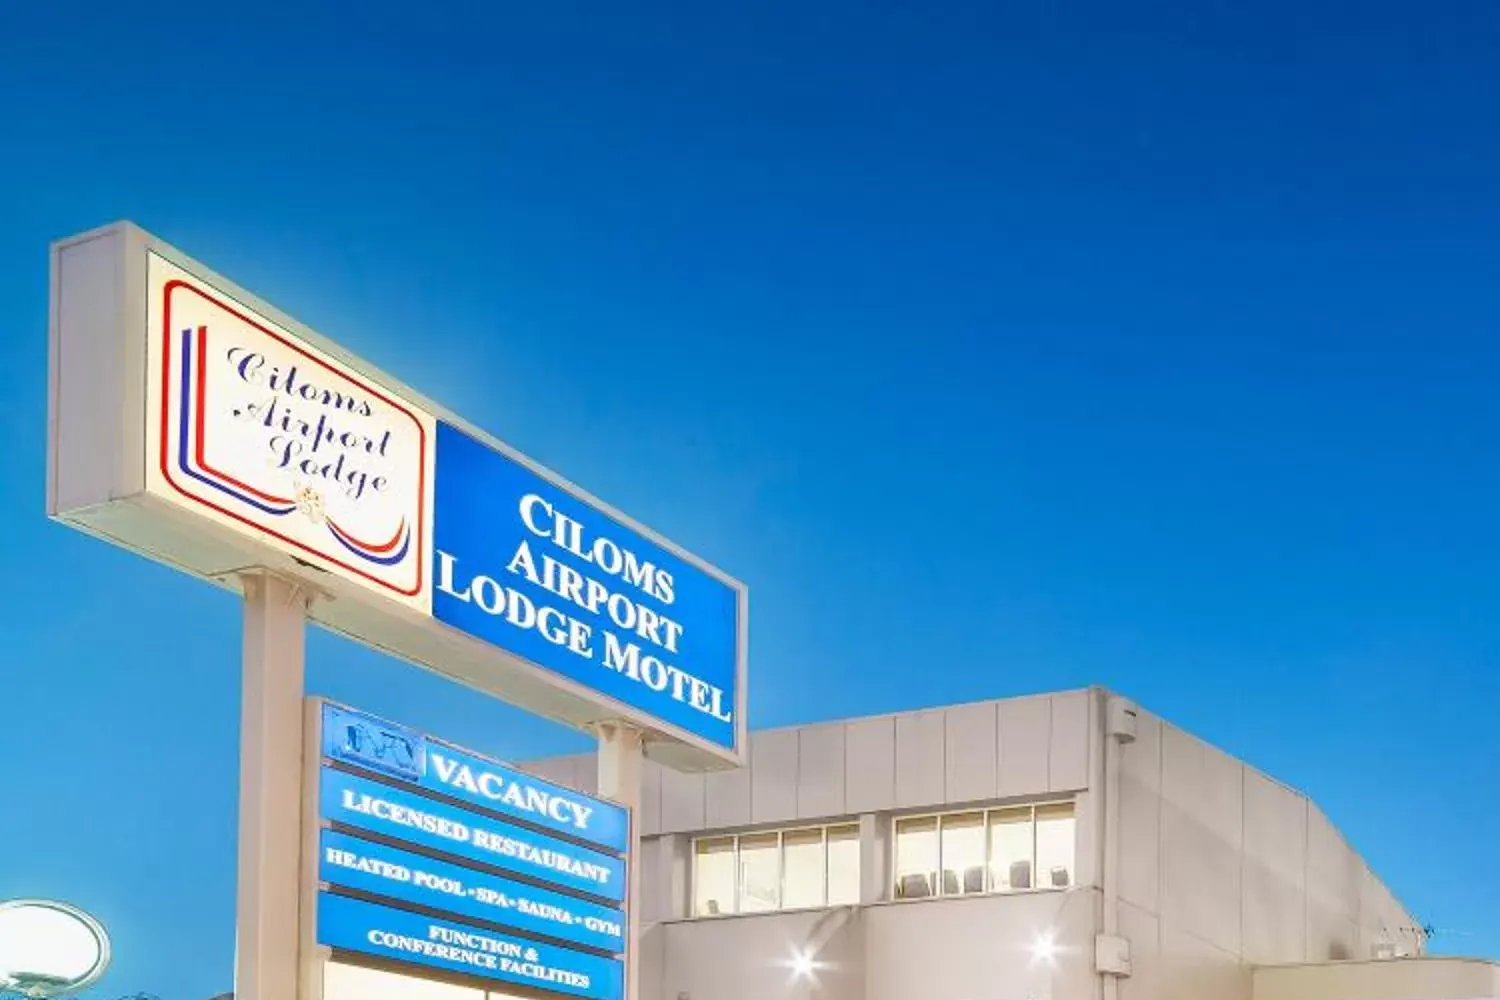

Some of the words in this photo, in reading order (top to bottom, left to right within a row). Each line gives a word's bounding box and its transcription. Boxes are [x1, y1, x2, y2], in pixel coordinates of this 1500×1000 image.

[228, 348, 371, 416] Ciloms
[233, 396, 390, 456] Airport
[270, 435, 387, 499] Lodge
[520, 494, 675, 604] CILOMS
[506, 540, 683, 653] AIRPORT
[435, 550, 593, 659] LODGE
[602, 631, 732, 723] MOTEL
[432, 754, 593, 830] VACANCY
[342, 789, 469, 842] LICENSED
[473, 827, 611, 884] RESTAURANT
[326, 847, 410, 881] HEATED
[413, 870, 467, 896] POOL
[476, 887, 509, 908] SPA
[517, 897, 573, 924] SAUNA
[585, 916, 621, 937] GYM
[367, 929, 497, 968] CONFERENCE
[500, 957, 590, 989] FACILITIES
[429, 925, 521, 958] FUNCTION
[524, 947, 538, 962] &
